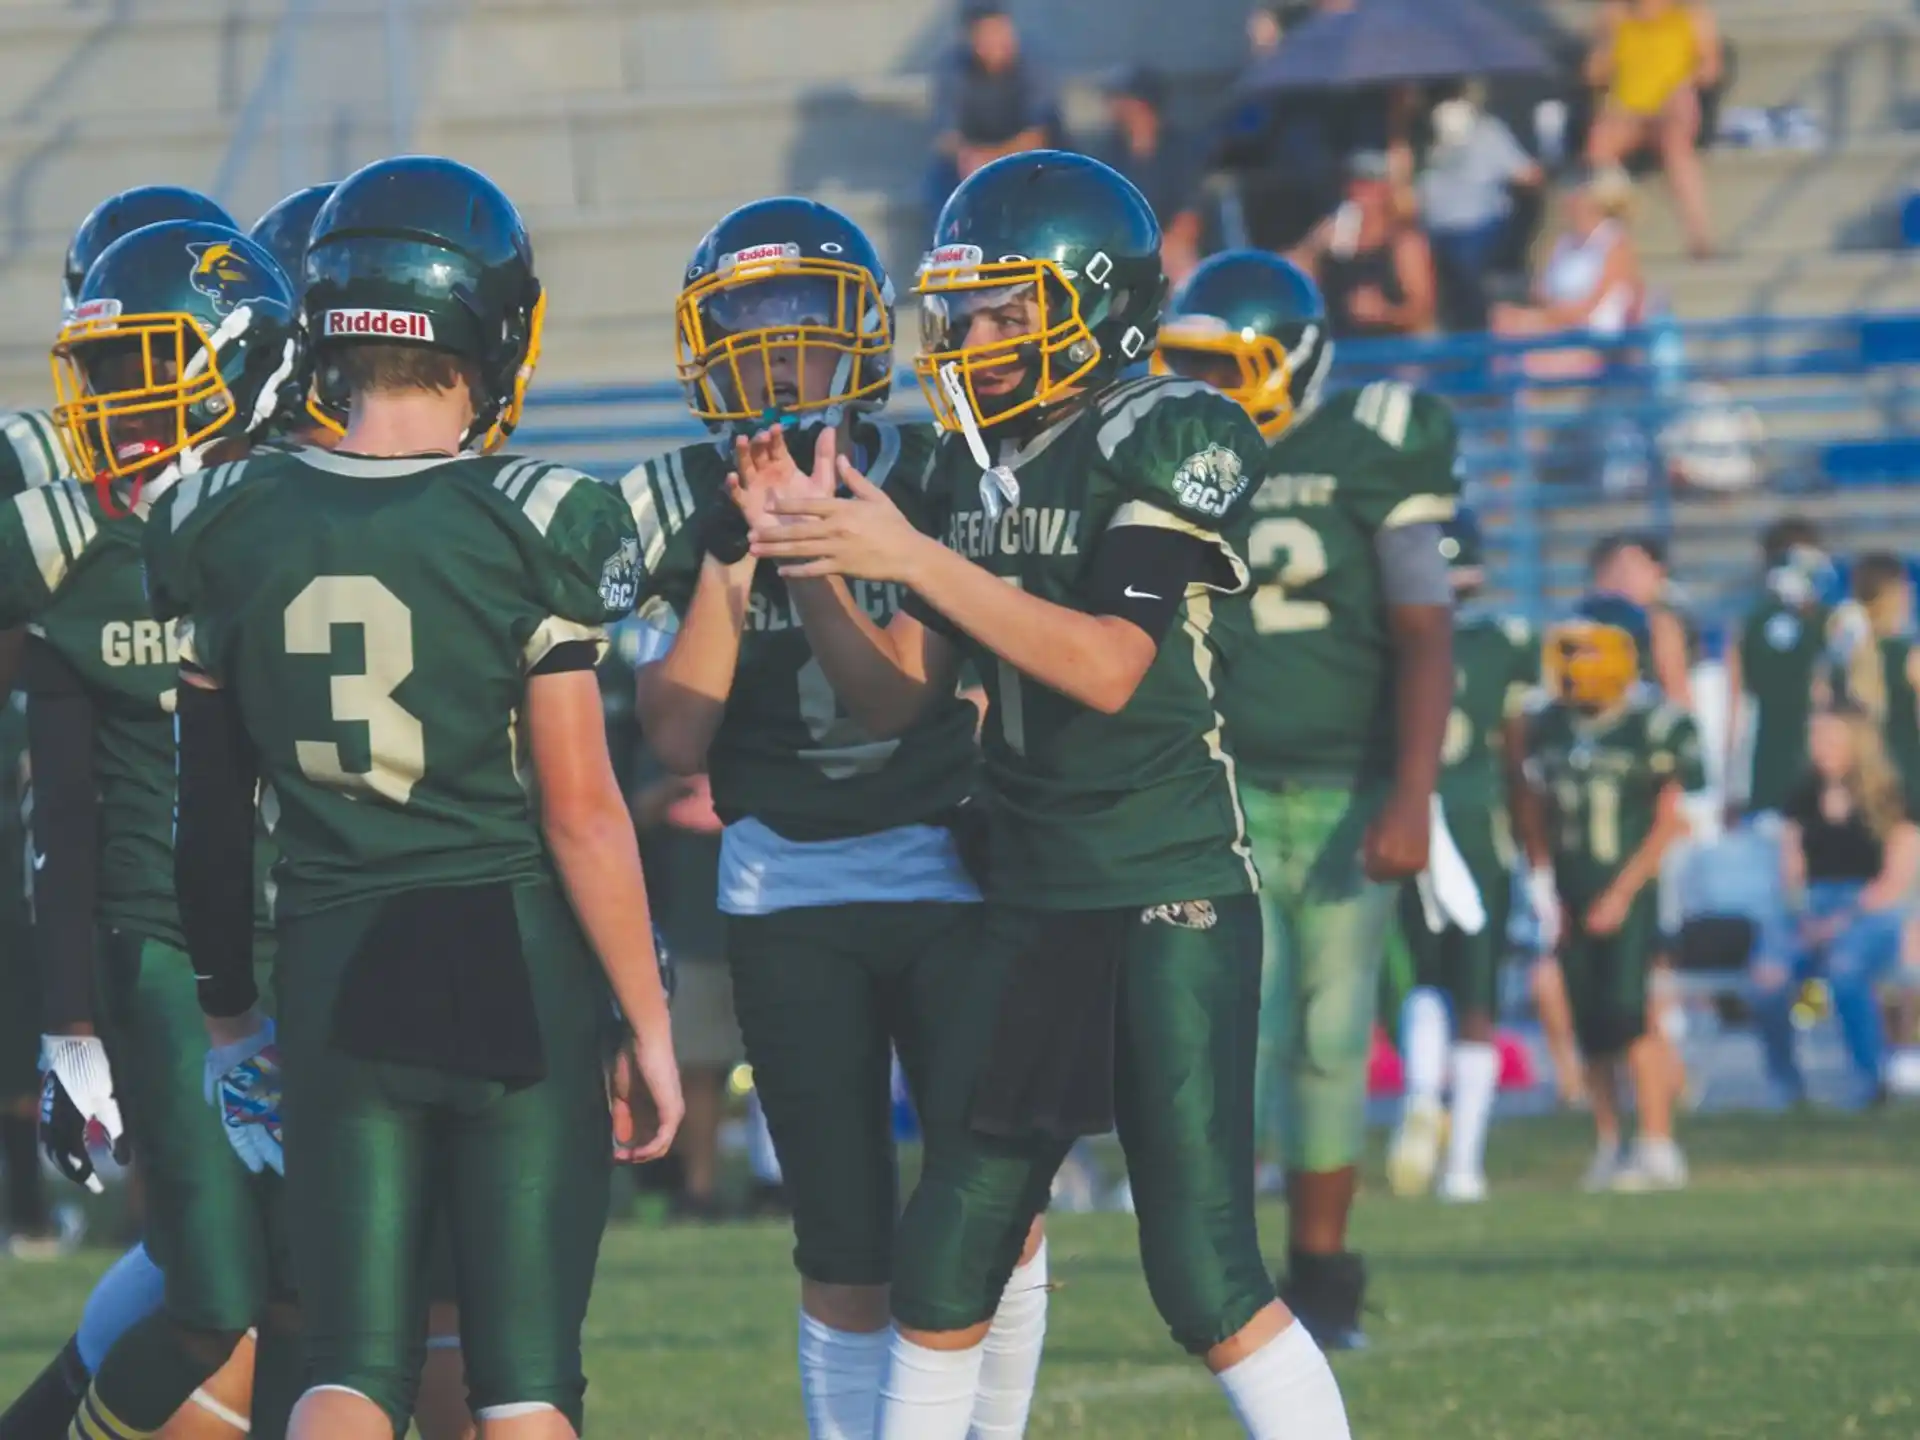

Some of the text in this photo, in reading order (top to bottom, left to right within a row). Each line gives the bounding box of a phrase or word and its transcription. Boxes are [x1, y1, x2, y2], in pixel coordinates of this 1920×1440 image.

[329, 311, 426, 337] Riddell
[1248, 517, 1331, 635] 2
[284, 575, 425, 805] 3
